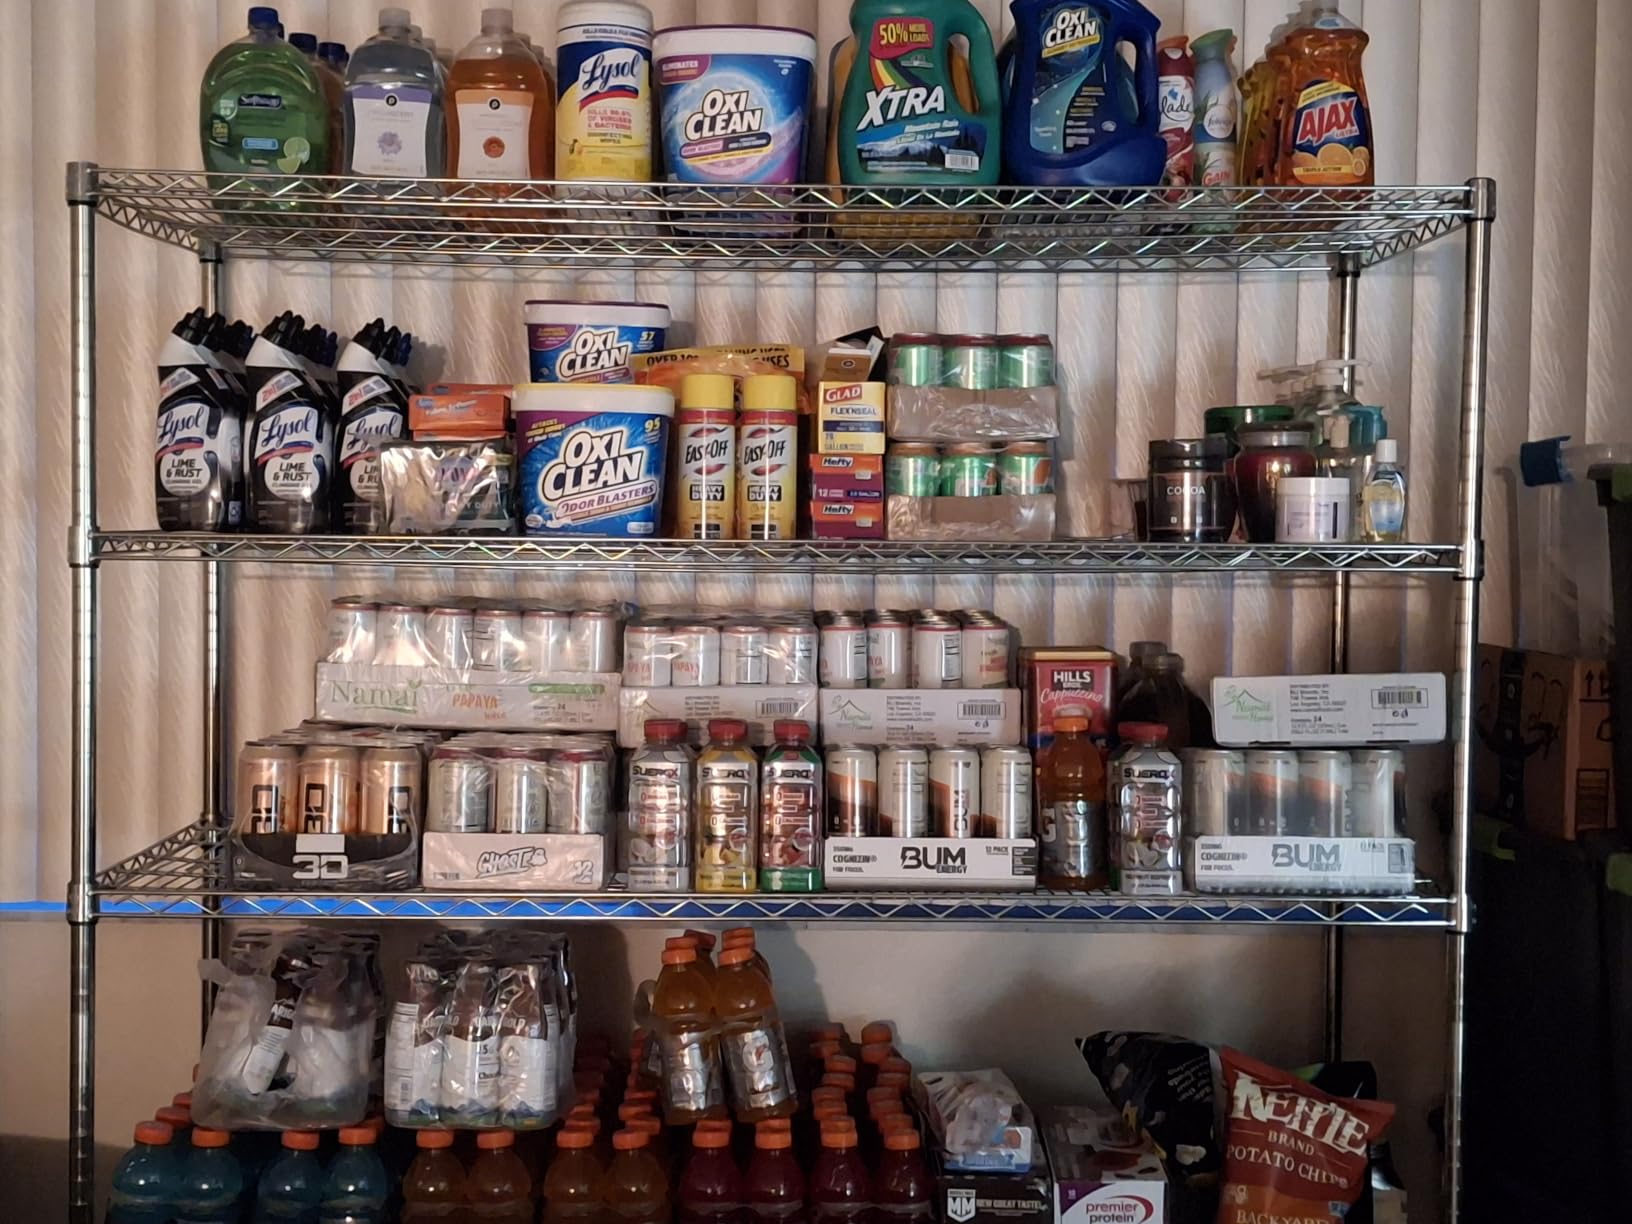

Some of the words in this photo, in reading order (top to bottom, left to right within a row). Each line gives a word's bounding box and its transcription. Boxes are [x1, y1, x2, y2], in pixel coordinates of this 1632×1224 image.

[1057, 9, 1087, 30] OXI
[880, 23, 909, 45] 50%
[1045, 20, 1097, 48] CLEAN
[582, 53, 640, 91] Lysol
[702, 89, 749, 117] OXI
[856, 85, 945, 132] XTRA
[685, 108, 763, 141] CLEAN
[1298, 98, 1358, 145] AJAX
[575, 330, 616, 356] OXI
[561, 345, 629, 378] CLEAN
[826, 386, 861, 402] GLAD
[157, 406, 205, 445] Lysol
[261, 409, 315, 448] Lysol
[645, 418, 661, 432] 95
[564, 430, 624, 468] OXI
[171, 458, 197, 468] LIME
[174, 468, 204, 478] RUST
[280, 461, 305, 472] LIME
[364, 464, 379, 475] LIM
[823, 457, 851, 467] Hefty
[282, 471, 313, 482] RUST
[367, 473, 379, 484] RU
[541, 450, 644, 502] CLEAN
[561, 499, 596, 513] ODOR
[597, 483, 655, 505] BLASTERS
[691, 492, 723, 500] DUTY
[818, 488, 828, 498] 12
[824, 505, 852, 515] Hefty
[1053, 670, 1092, 684] HILLS
[900, 846, 966, 870] BUM
[1271, 843, 1340, 867] BUM
[1268, 1129, 1315, 1156] BRAND
[1227, 1144, 1295, 1171] POTATO
[1086, 1201, 1139, 1215] premier
[1089, 1212, 1134, 1224] protein
